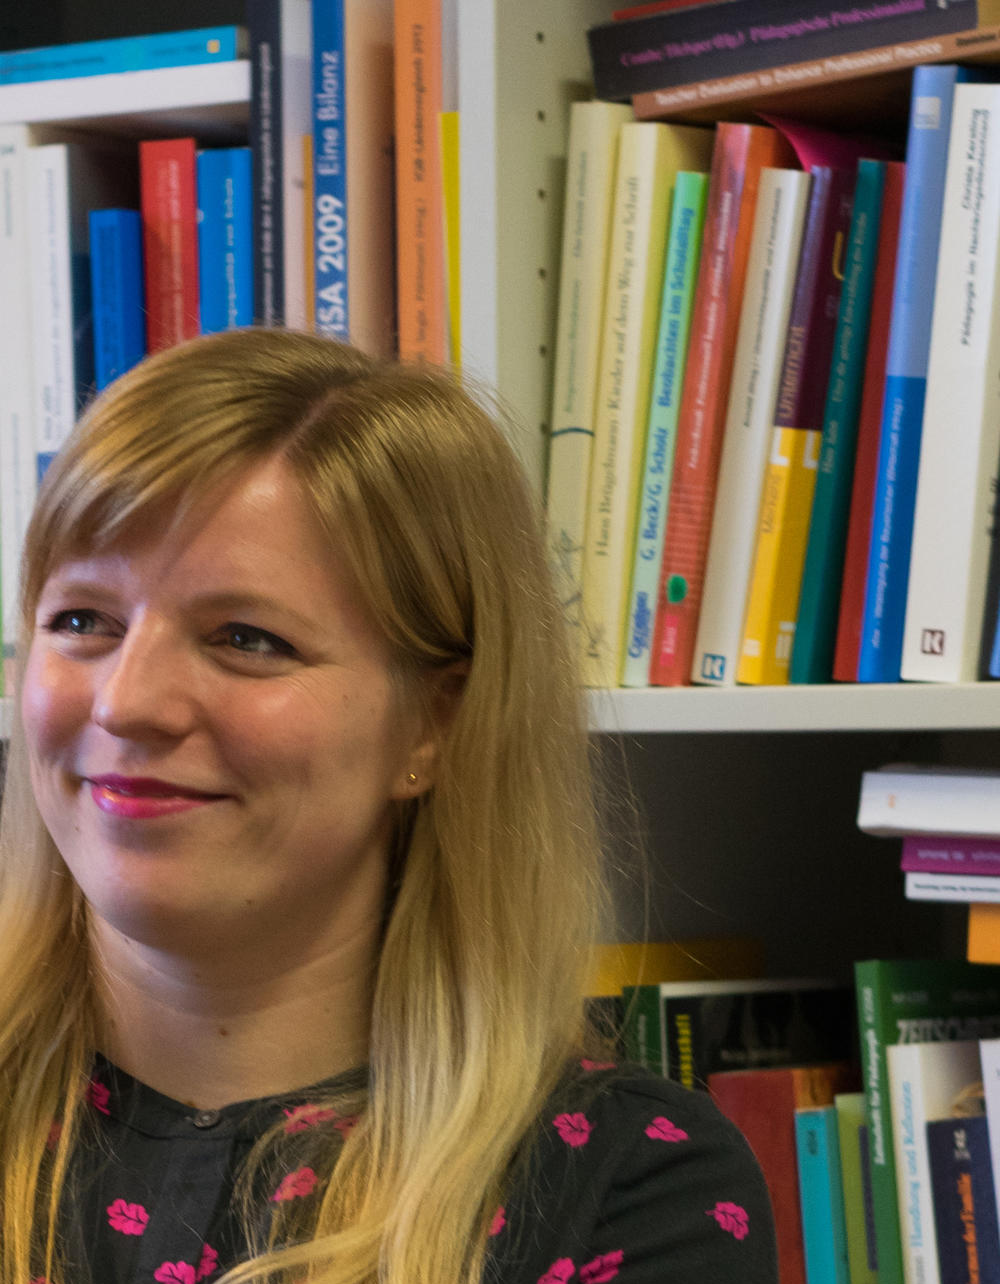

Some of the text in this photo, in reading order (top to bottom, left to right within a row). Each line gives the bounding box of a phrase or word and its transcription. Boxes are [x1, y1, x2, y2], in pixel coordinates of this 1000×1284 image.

[961, 107, 982, 209] Christa Kersting
[967, 107, 989, 255] Nachkriegsdeutschland
[315, 49, 347, 337] ISA 2009 Eine Bilanz
[671, 207, 695, 289] Schulalltag
[669, 295, 683, 315] im
[843, 263, 863, 323] Entwicklung
[959, 281, 977, 345] Pädagogik
[595, 175, 639, 557] Hans Brügelmann Kinder auf dem Weg zur Schrift
[657, 319, 679, 407] Beobachten
[779, 325, 805, 419] Unterricht
[649, 427, 669, 475] Scholz
[643, 479, 663, 540] Beck/G.
[639, 542, 657, 561] G.
[865, 1029, 885, 1165] Zeitschrift für Pädagogik
[901, 1081, 915, 1145] Reflexion
[905, 1149, 919, 1176] und
[909, 1181, 923, 1247] Handlung
[957, 1173, 975, 1221] Familie
[963, 1219, 977, 1246] der
